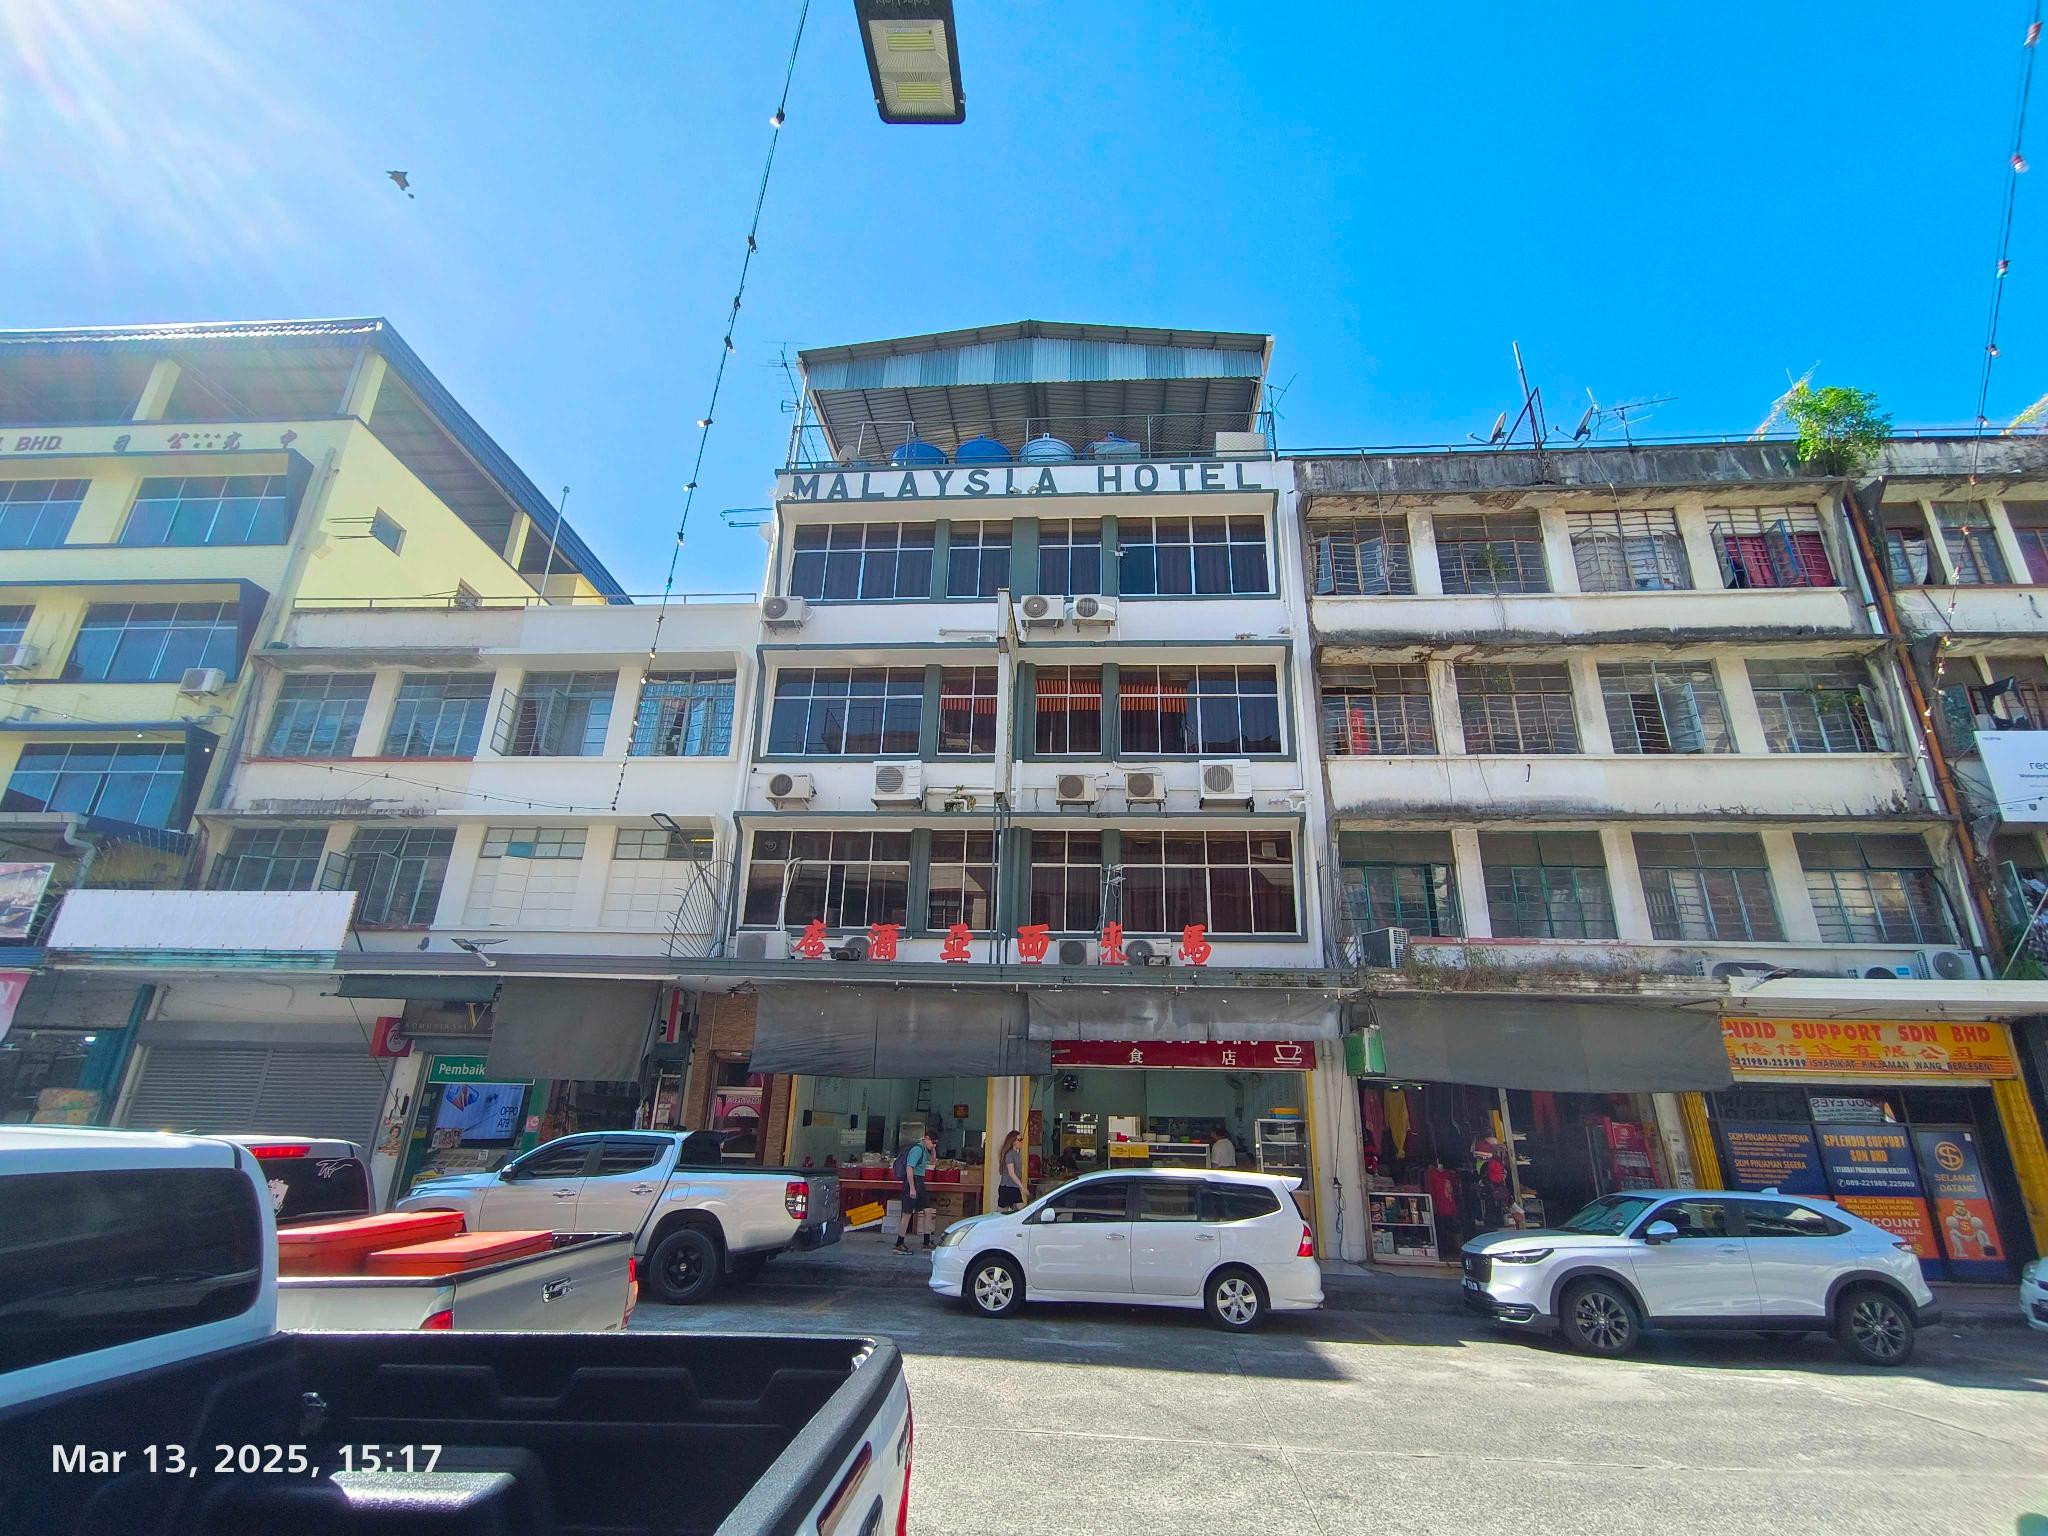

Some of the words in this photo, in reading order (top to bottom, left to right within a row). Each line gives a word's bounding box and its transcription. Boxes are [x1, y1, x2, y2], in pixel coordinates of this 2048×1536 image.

[793, 468, 1057, 500] MALAYSIA
[1097, 463, 1262, 494] HOTEL
[1790, 1022, 1882, 1041] SUPPORT
[1897, 1024, 1938, 1042] SDN
[1950, 1025, 1990, 1042] BHD
[1914, 1061, 1942, 1070] WANG
[500, 1106, 519, 1116] OPPO
[1823, 1134, 1866, 1147] SPLENDID
[1866, 1135, 1905, 1148] SUPPORT
[1934, 1173, 1977, 1182] SELAMAT
[1939, 1184, 1977, 1193] DATANG
[1863, 1217, 1921, 1228] COUNT
